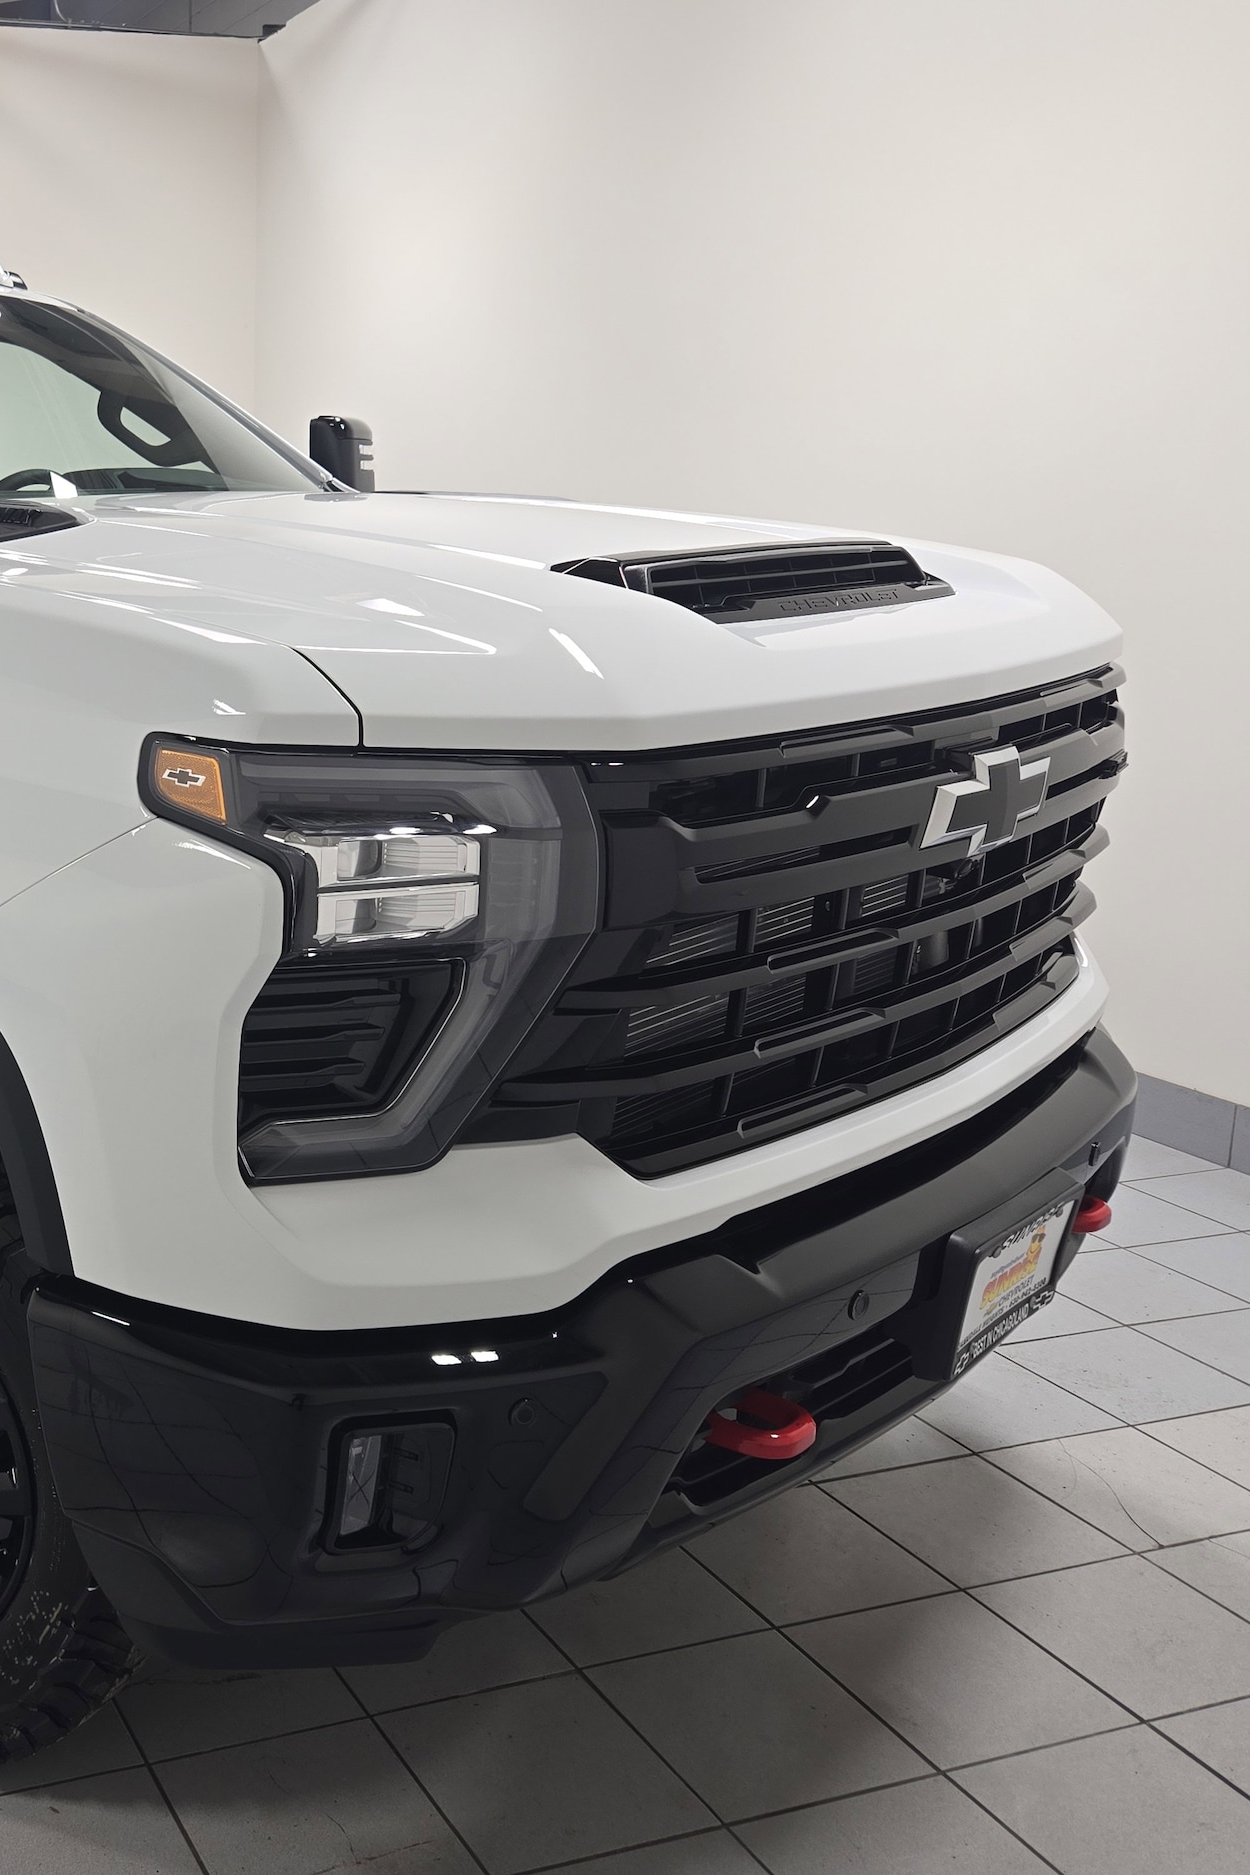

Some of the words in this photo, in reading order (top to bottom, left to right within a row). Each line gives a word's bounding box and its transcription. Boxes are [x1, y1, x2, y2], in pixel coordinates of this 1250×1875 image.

[778, 588, 899, 612] CHEVROLET
[997, 1274, 1035, 1307] CHEVROLET
[972, 1334, 988, 1359] BEST
